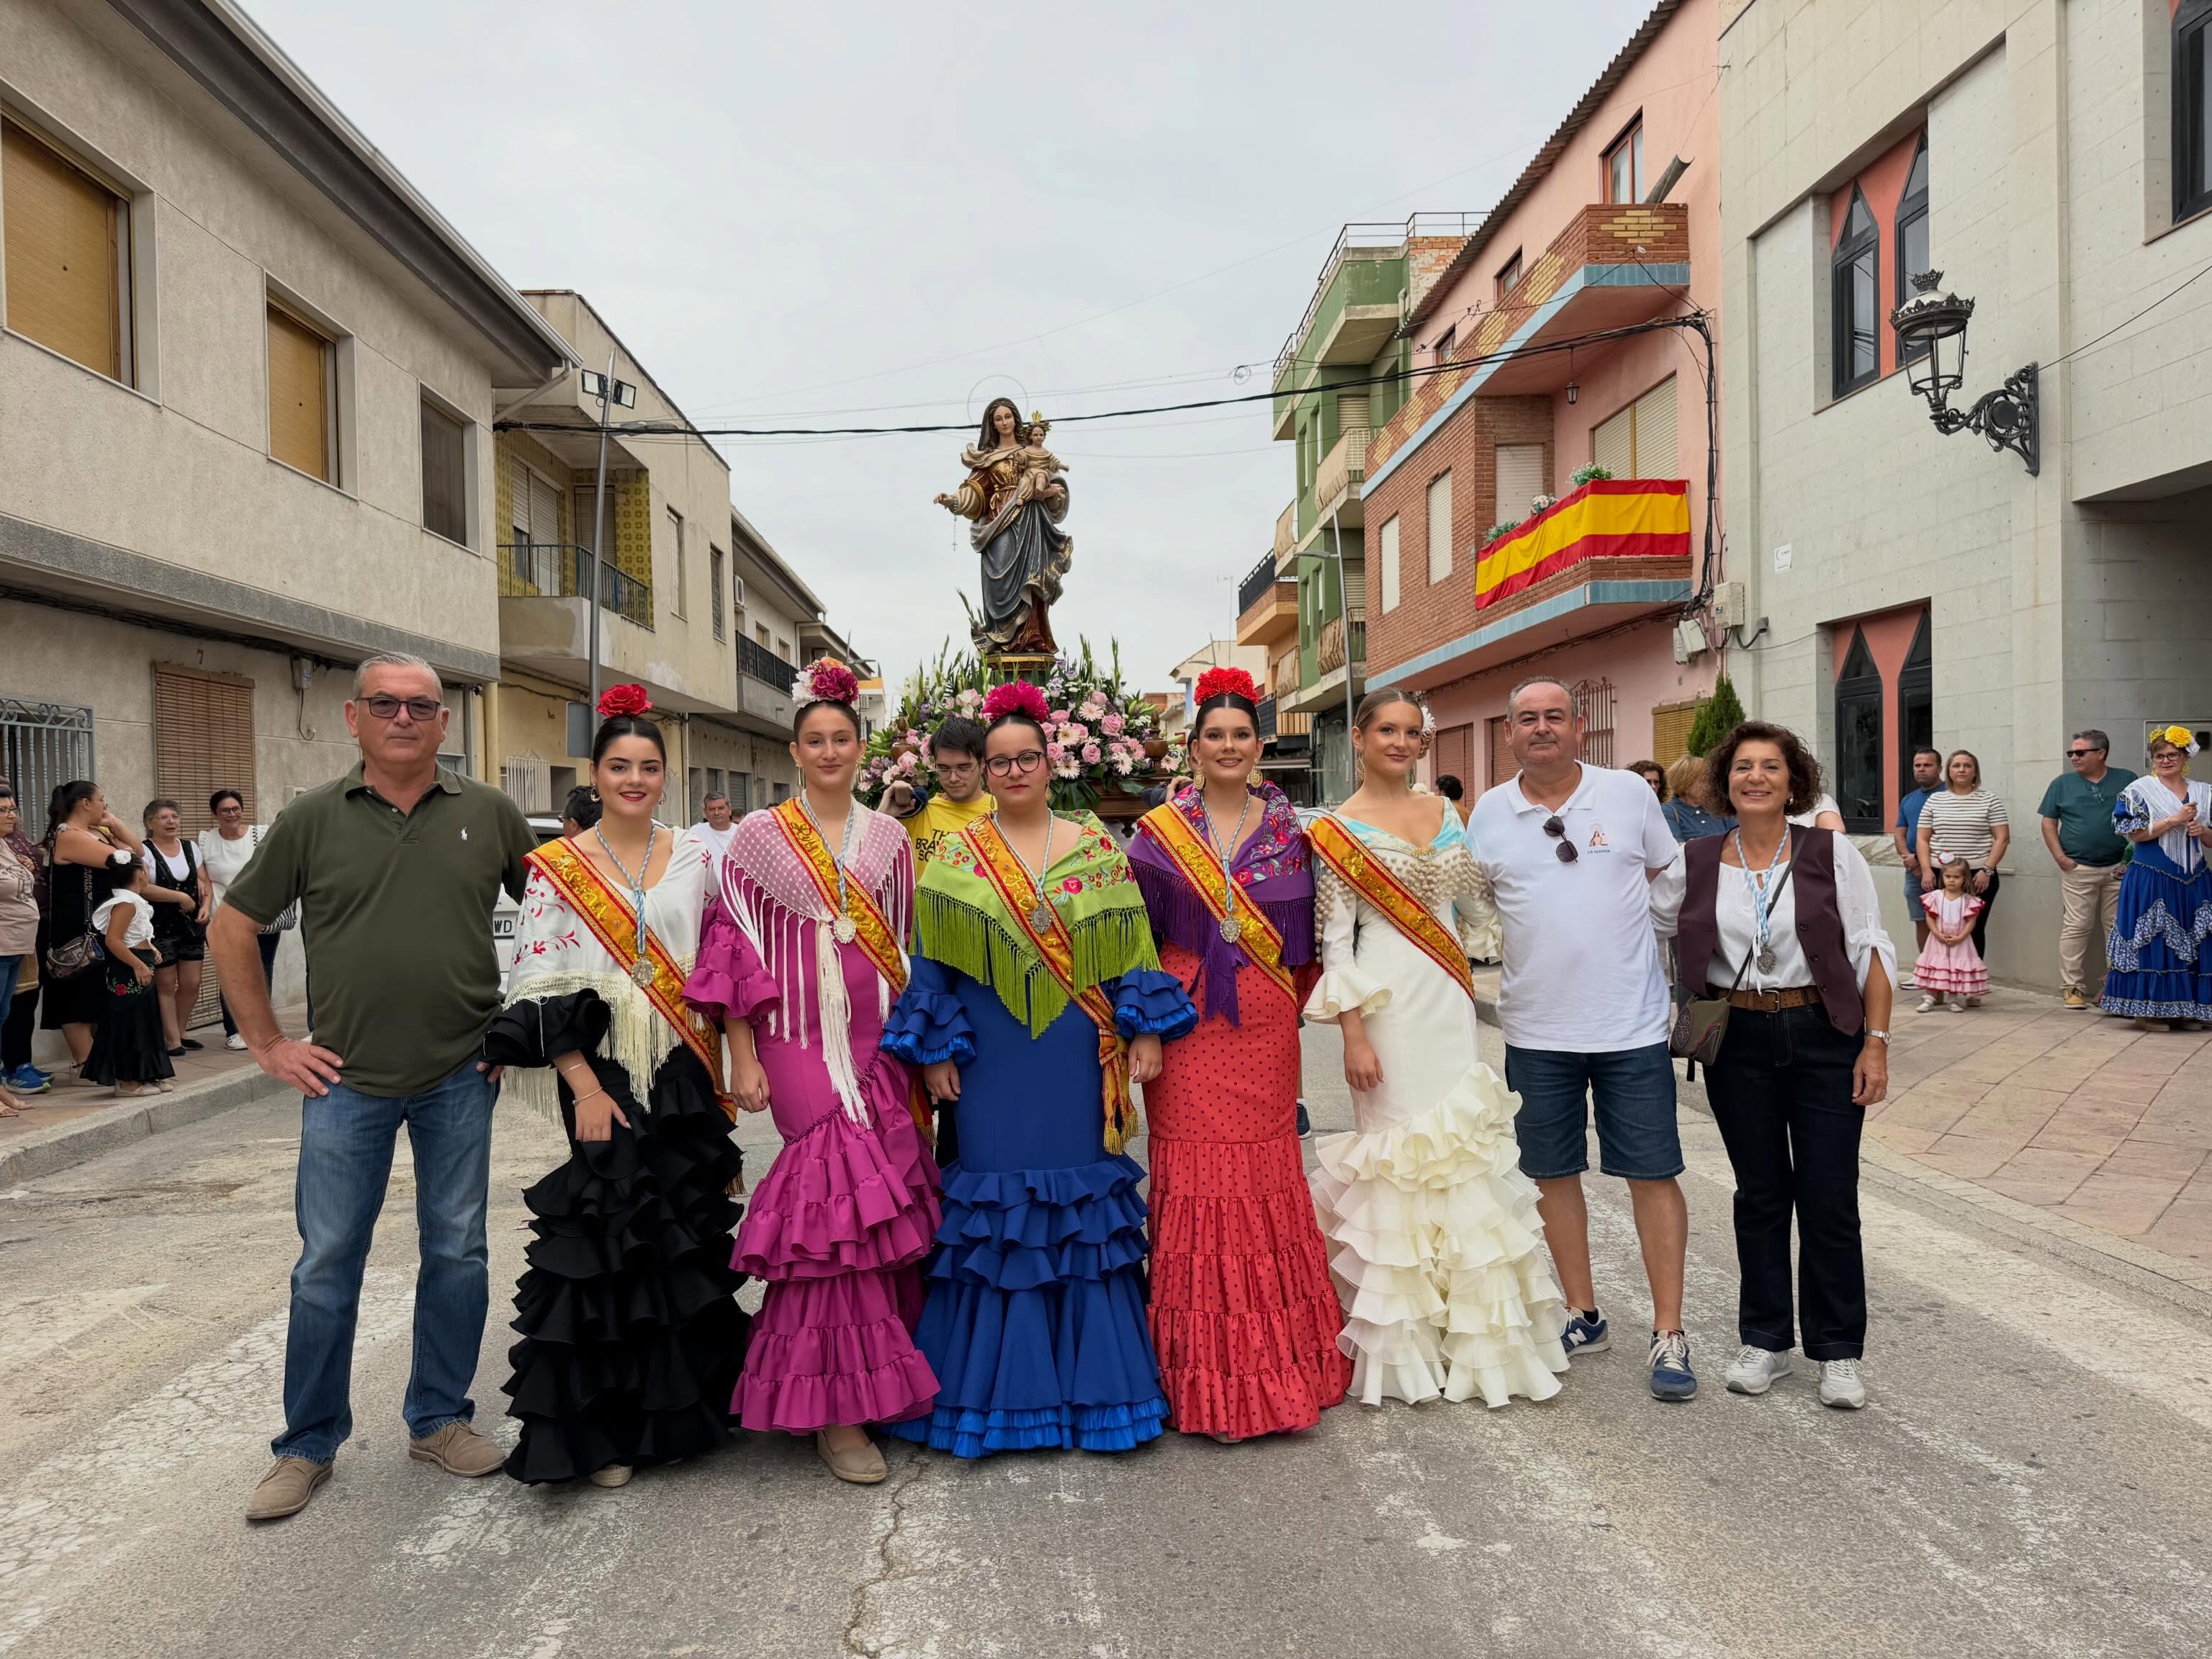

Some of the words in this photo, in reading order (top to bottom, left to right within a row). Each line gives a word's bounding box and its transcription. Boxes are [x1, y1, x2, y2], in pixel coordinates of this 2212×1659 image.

[197, 649, 204, 665] 7
[932, 828, 953, 840] TH
[549, 854, 607, 922] Reina
